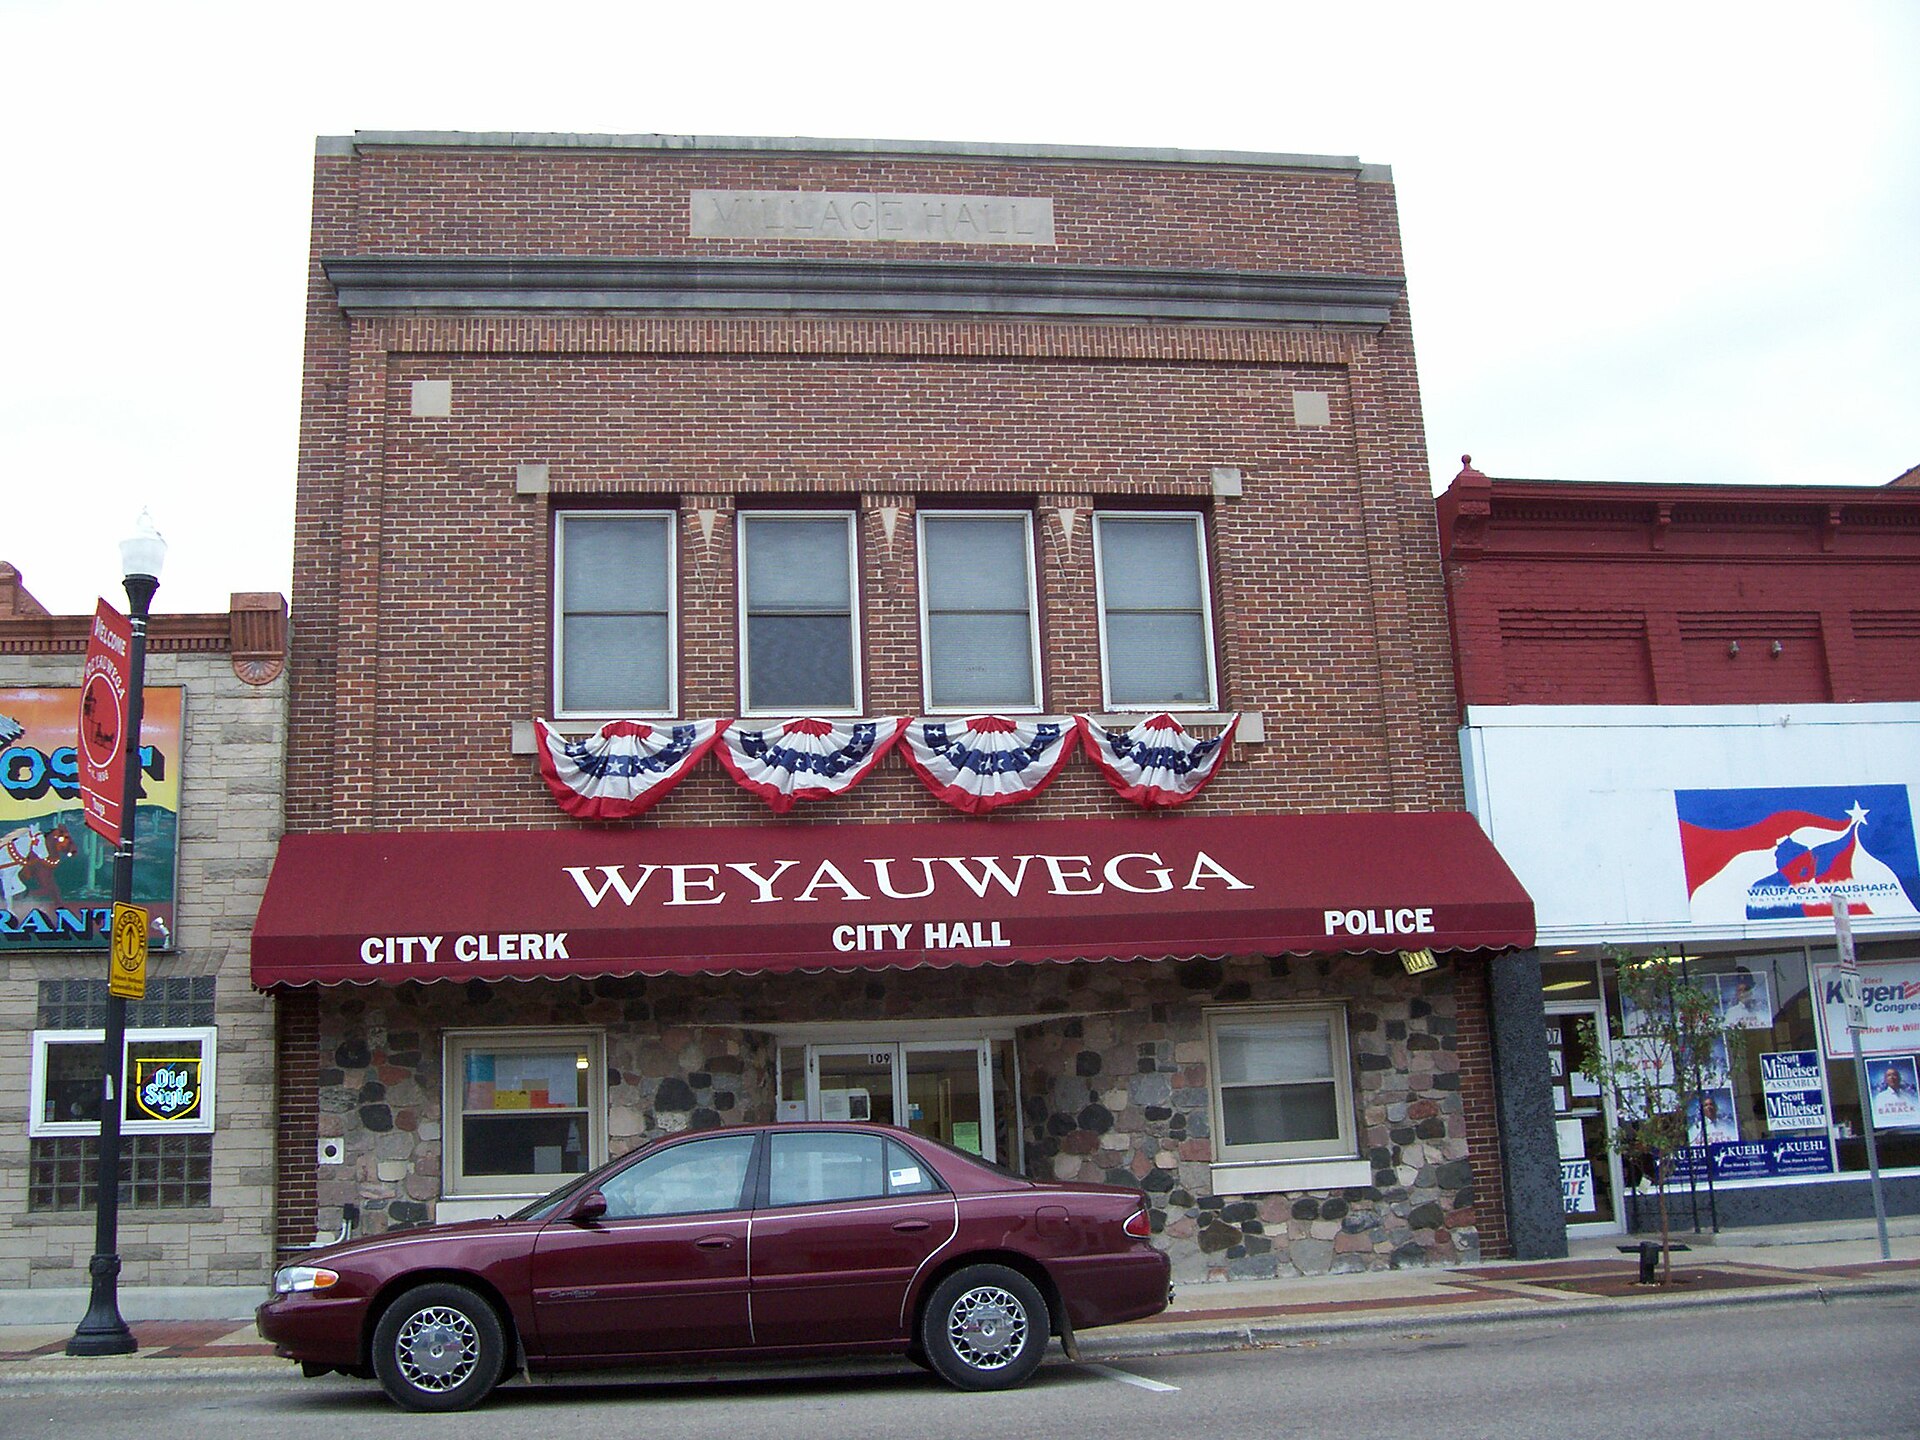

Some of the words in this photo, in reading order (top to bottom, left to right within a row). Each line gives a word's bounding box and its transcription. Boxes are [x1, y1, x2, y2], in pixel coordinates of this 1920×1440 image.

[712, 197, 903, 232] VILLAGE
[921, 202, 1034, 235] HALL
[561, 850, 1255, 908] WEYAUWEGA
[1747, 885, 1817, 897] WAUPACA
[1820, 882, 1899, 894] WAUSHARA
[1323, 908, 1435, 936] POLICE
[832, 924, 913, 952] CITY
[925, 921, 1011, 950] HALL
[360, 936, 444, 965] CITY
[453, 933, 570, 962] CLERK
[1826, 980, 1905, 1008] Kgen
[870, 1053, 890, 1064] 109
[1776, 1054, 1800, 1064] Scott
[1763, 1059, 1819, 1079] Milheiser
[155, 1068, 188, 1088] Old
[1772, 1079, 1818, 1089] ASSEMBLY
[1781, 1092, 1805, 1101] Scott
[1768, 1097, 1824, 1117] Milheiser
[1878, 1105, 1917, 1115] BARACK
[1776, 1117, 1823, 1126] ASSEMBLY
[1727, 1145, 1768, 1156] KUEHL
[1786, 1141, 1826, 1152] KUEHL
